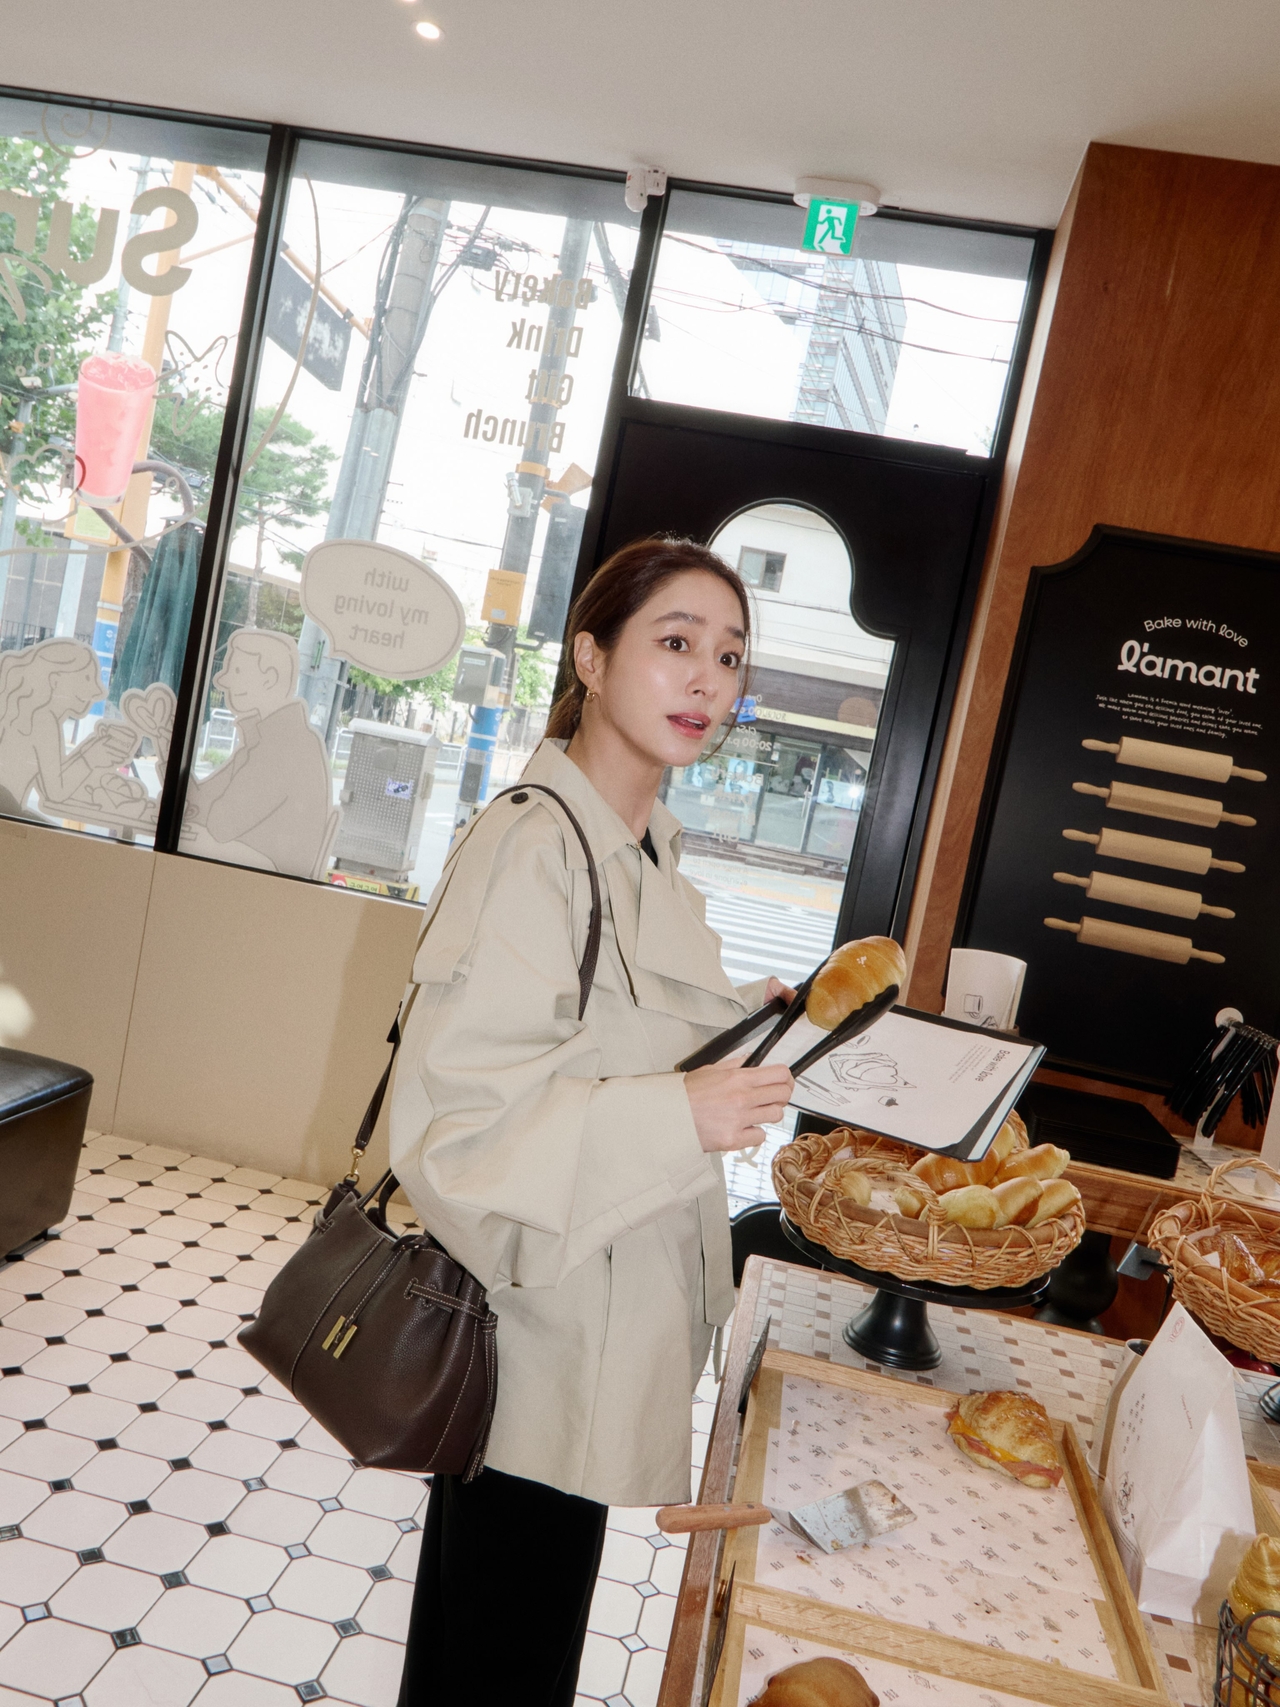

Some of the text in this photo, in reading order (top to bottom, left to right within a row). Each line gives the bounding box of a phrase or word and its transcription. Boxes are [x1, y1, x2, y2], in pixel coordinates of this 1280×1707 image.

[1143, 616, 1249, 648] Bake with love
[1117, 639, 1260, 694] l'amant
